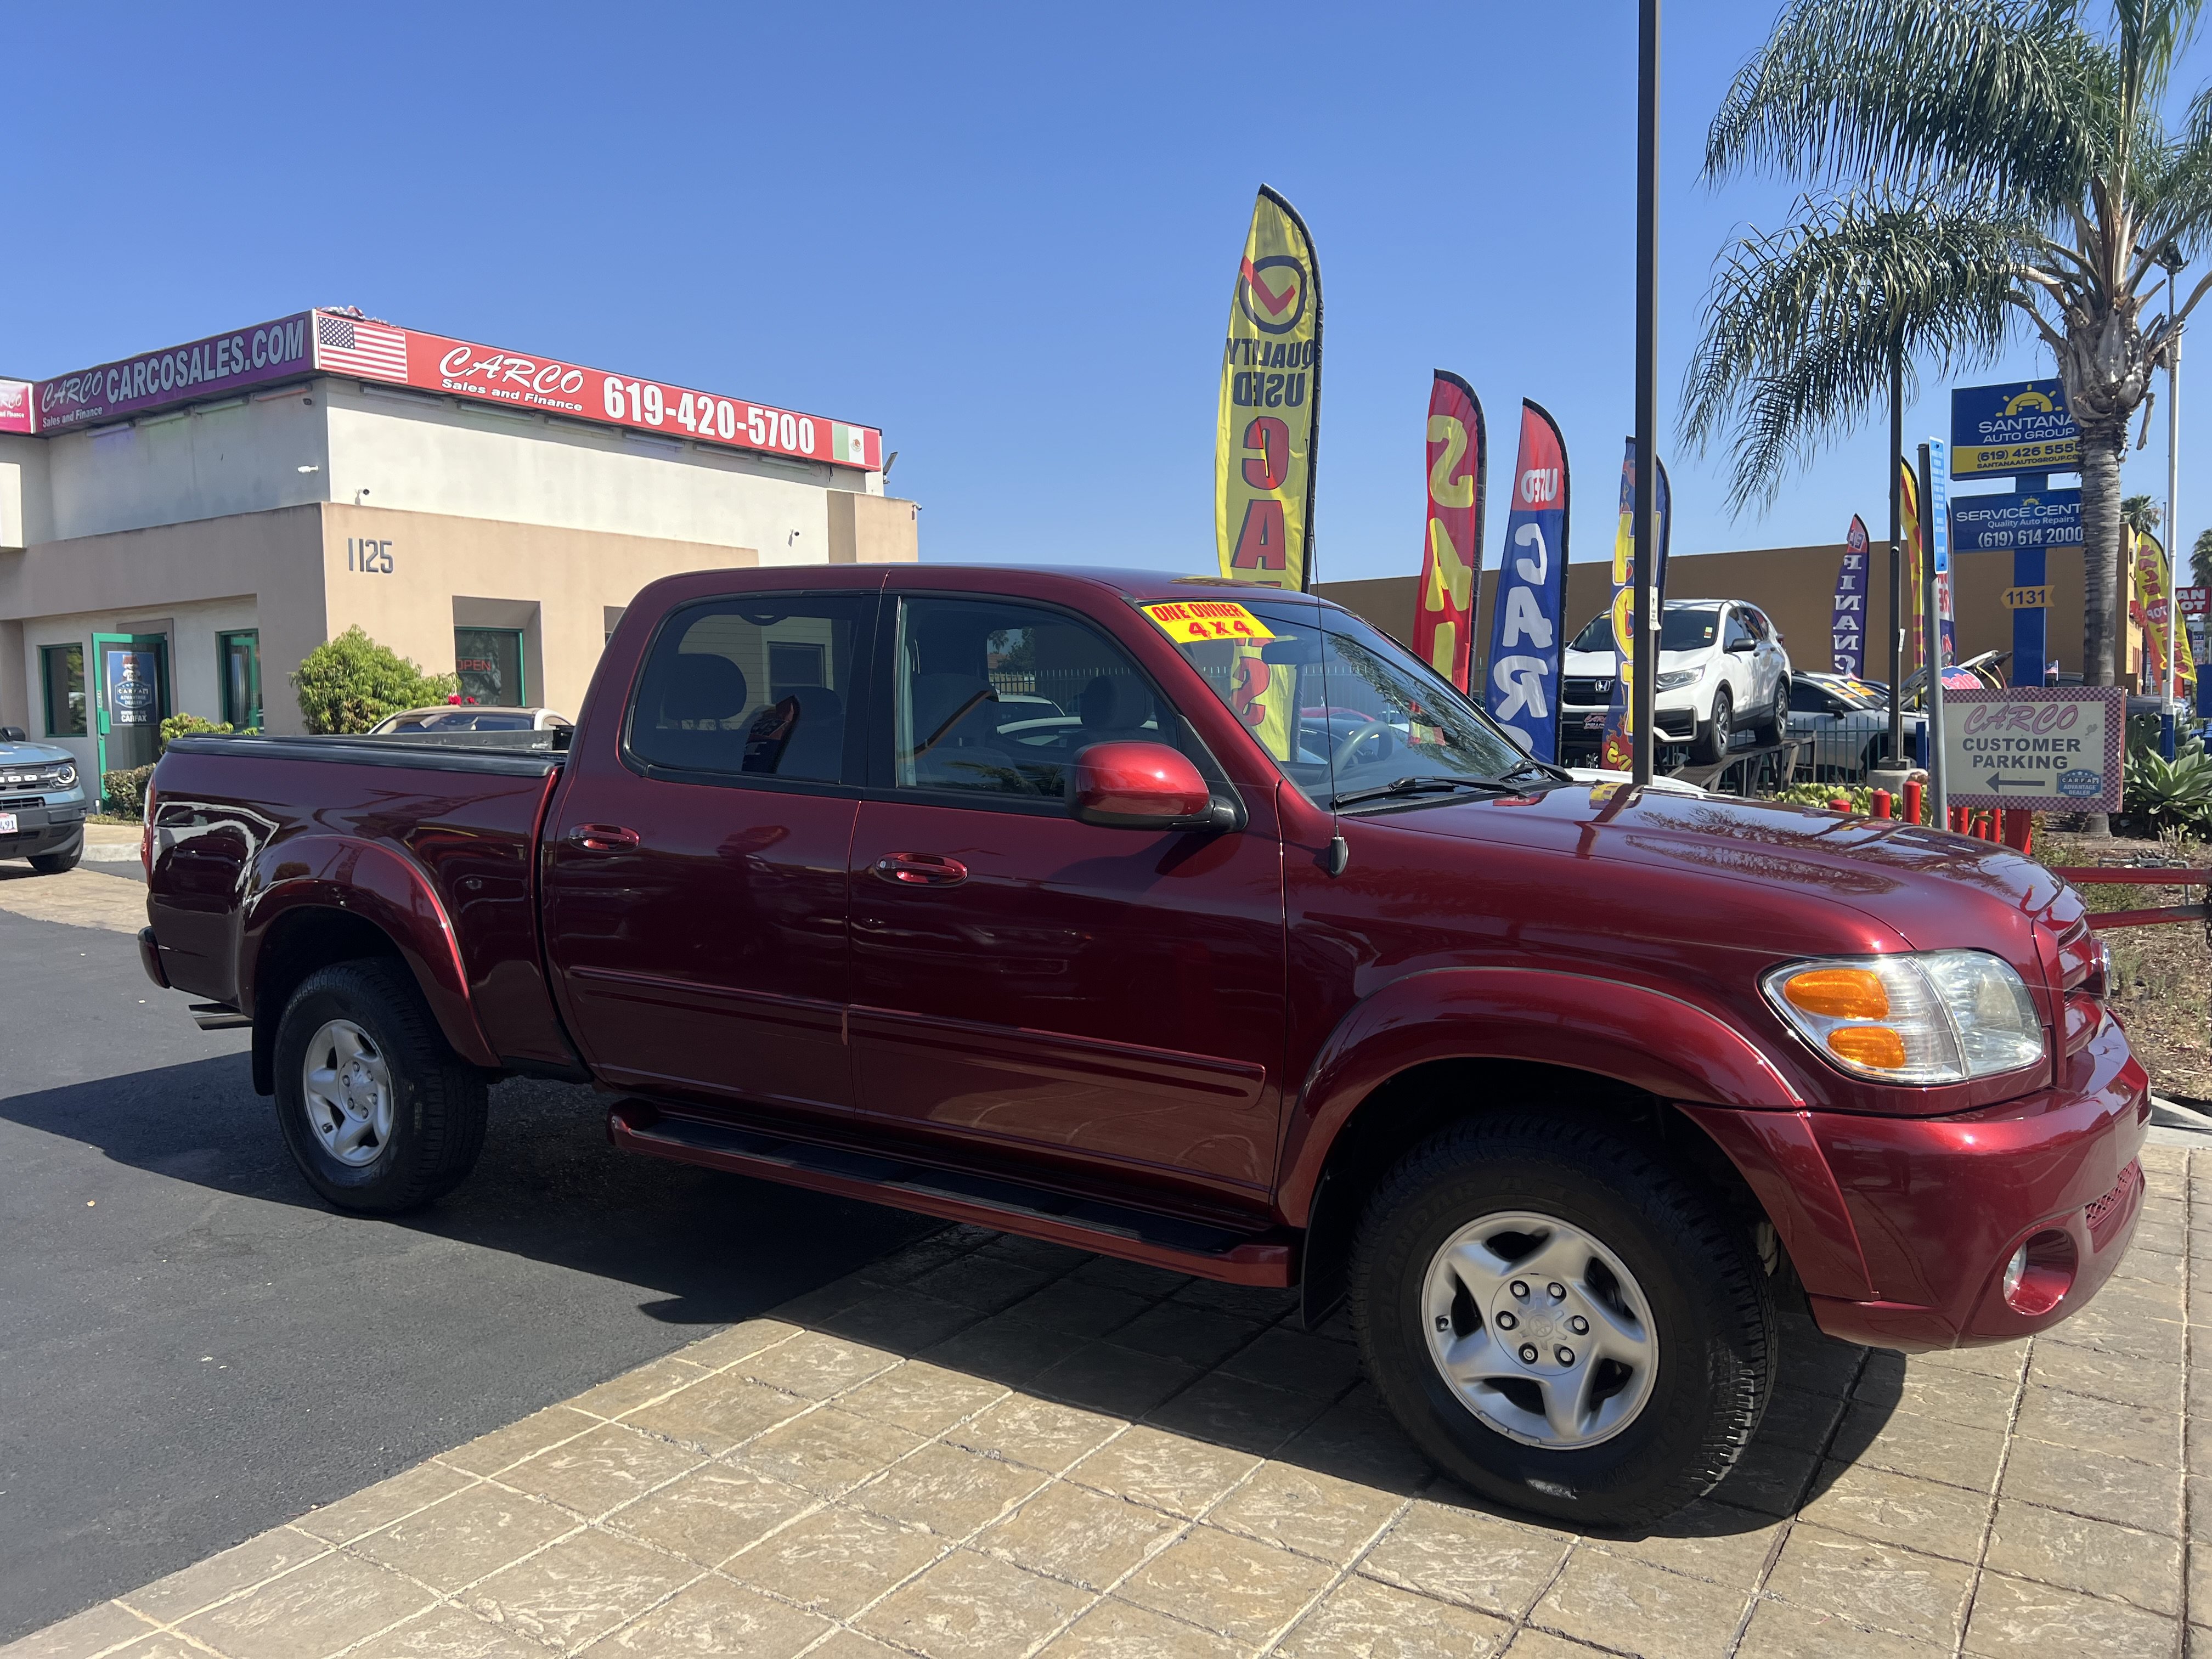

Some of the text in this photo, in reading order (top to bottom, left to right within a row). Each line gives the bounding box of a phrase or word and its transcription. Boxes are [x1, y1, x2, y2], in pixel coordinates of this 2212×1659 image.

[106, 318, 305, 404] CARCOSALES.COM
[439, 346, 584, 394] CARCO
[42, 371, 103, 413] CARCO
[442, 378, 583, 411] Sales and Finance
[43, 407, 103, 427] Sales and Finance
[603, 376, 815, 454] 619-420-5700
[1983, 427, 2075, 443] AUTO GROUP
[1977, 443, 2083, 462] (619) 426 5555
[1977, 454, 2080, 469] SANTANAAUTOGROUP.CO
[1956, 503, 2081, 522] SERVICE CENT
[1988, 520, 2018, 528] Quality
[2042, 516, 2075, 525] Repairs
[1978, 526, 2083, 548] (619) 614 2000
[348, 538, 393, 573] 1125
[2006, 590, 2045, 605] 1131
[1152, 603, 1248, 622] ONE OWNER
[456, 659, 492, 671] OPEN
[1964, 704, 2078, 735] CARCO
[1962, 738, 2081, 752] CUSTOMER
[1972, 755, 2068, 769] PARKING
